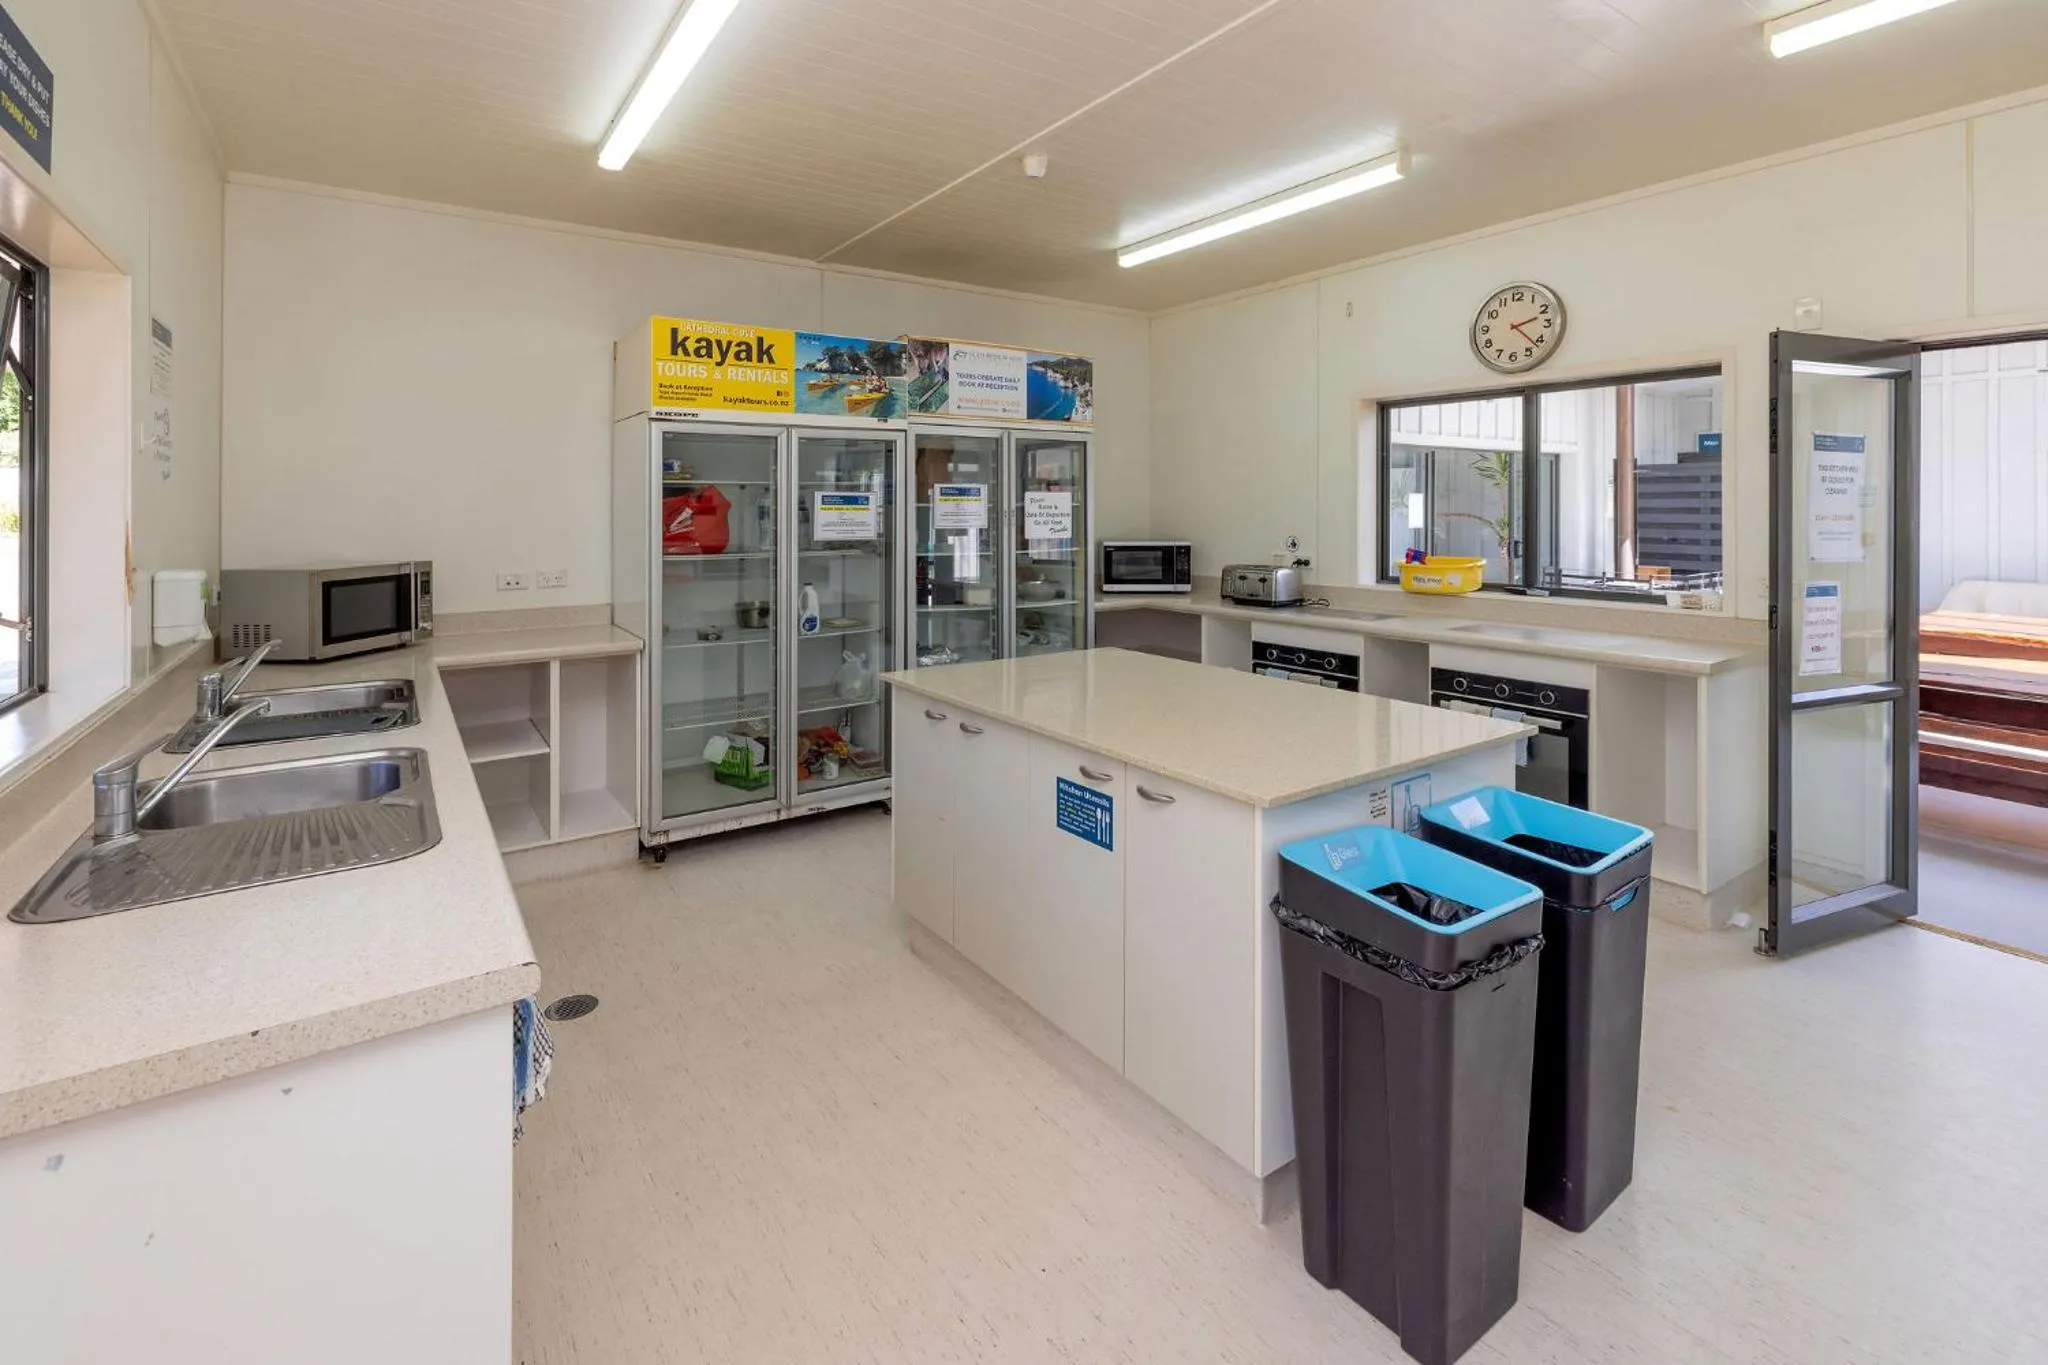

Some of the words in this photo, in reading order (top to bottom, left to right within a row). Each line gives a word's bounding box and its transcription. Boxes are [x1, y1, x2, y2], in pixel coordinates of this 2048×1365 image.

[0, 32, 18, 65] EASE
[1499, 297, 1508, 308] 11
[1512, 291, 1525, 303] 12
[1531, 294, 1536, 304] 1
[1487, 309, 1499, 320] 10
[1539, 303, 1549, 315] 2
[1543, 318, 1552, 329] 3
[680, 321, 730, 335] CATHEDRAL
[733, 328, 756, 338] COVE
[1481, 325, 1490, 335] 9
[1484, 338, 1494, 349] 8
[1535, 334, 1545, 344] 4
[670, 327, 776, 367] kayak
[1524, 347, 1533, 357] 5
[1495, 348, 1504, 359] 7
[1508, 351, 1518, 362] 6
[656, 361, 708, 379] TOURS
[713, 370, 723, 380] &
[727, 367, 789, 385] RENTALS
[956, 372, 977, 380] TOURS
[977, 374, 1003, 382] OPERATE
[985, 383, 1018, 391] RECEPTION
[723, 395, 789, 407] kayaktours.co.nz
[1059, 782, 1084, 798] Kitchen
[1083, 790, 1110, 808] Utensils
